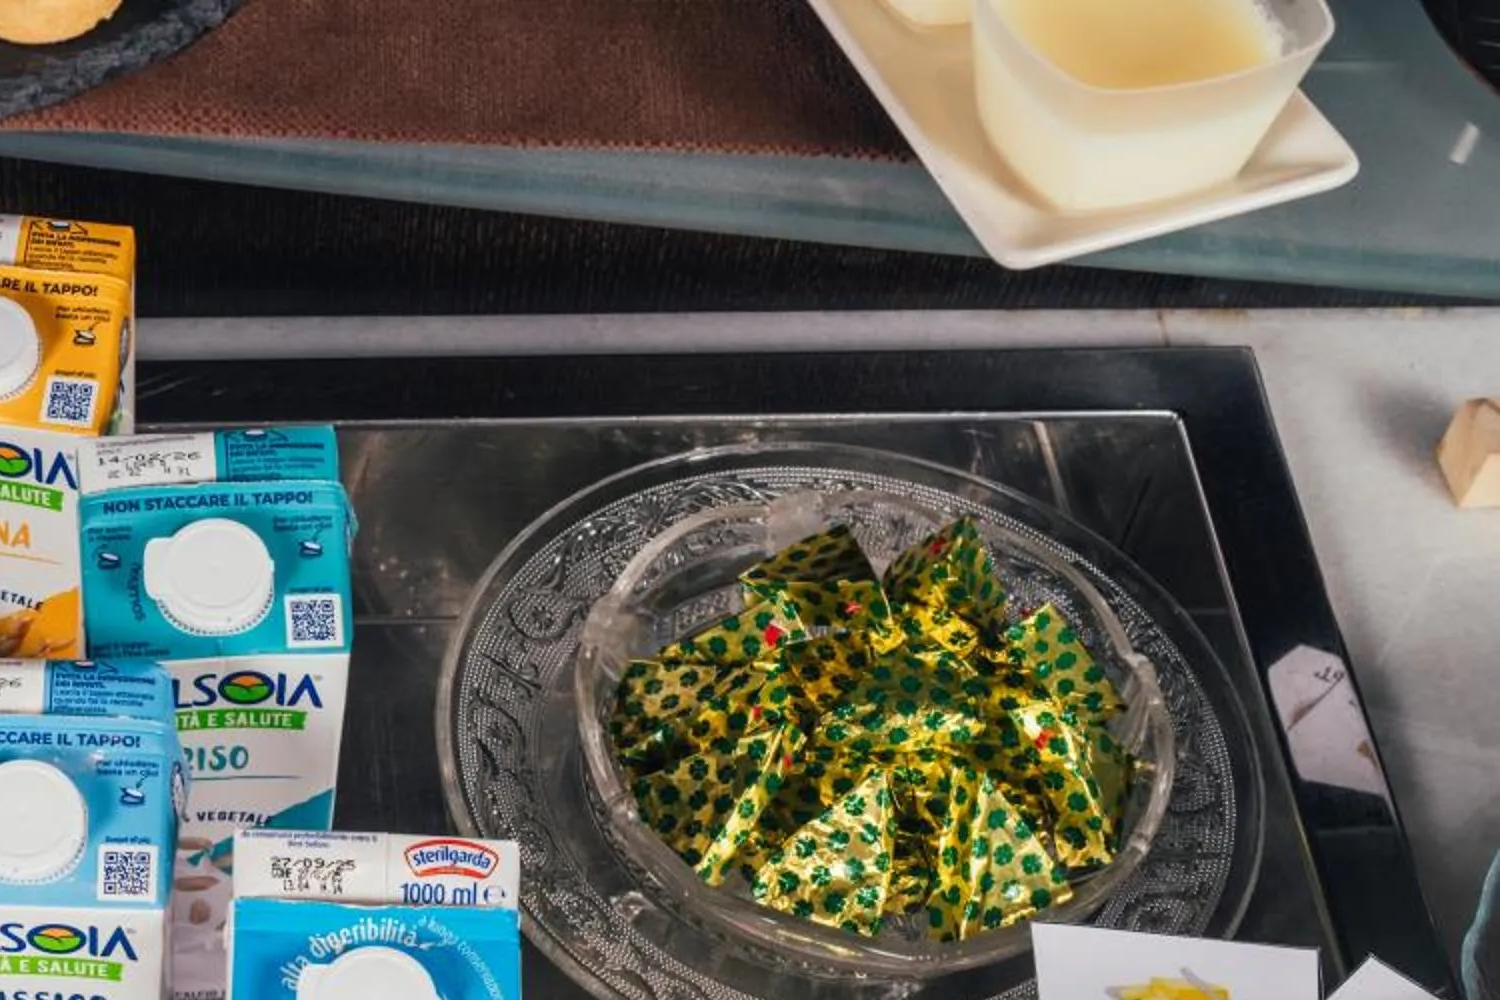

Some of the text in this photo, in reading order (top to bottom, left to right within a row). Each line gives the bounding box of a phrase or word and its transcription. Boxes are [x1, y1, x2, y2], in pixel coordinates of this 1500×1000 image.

[24, 281, 38, 293] IL
[42, 282, 98, 296] TAPPO!
[104, 491, 313, 513] NON STACCARE IL TAPPO!
[172, 671, 323, 708] LSOIA
[224, 713, 292, 727] SALUTE
[58, 733, 72, 746] IL
[77, 733, 141, 748] TAPPO!
[412, 847, 491, 871] sterilgarda
[400, 884, 477, 903] 1000 ml
[309, 916, 417, 959] digeribilità
[20, 960, 30, 972] E
[37, 959, 108, 977] SALUTE
